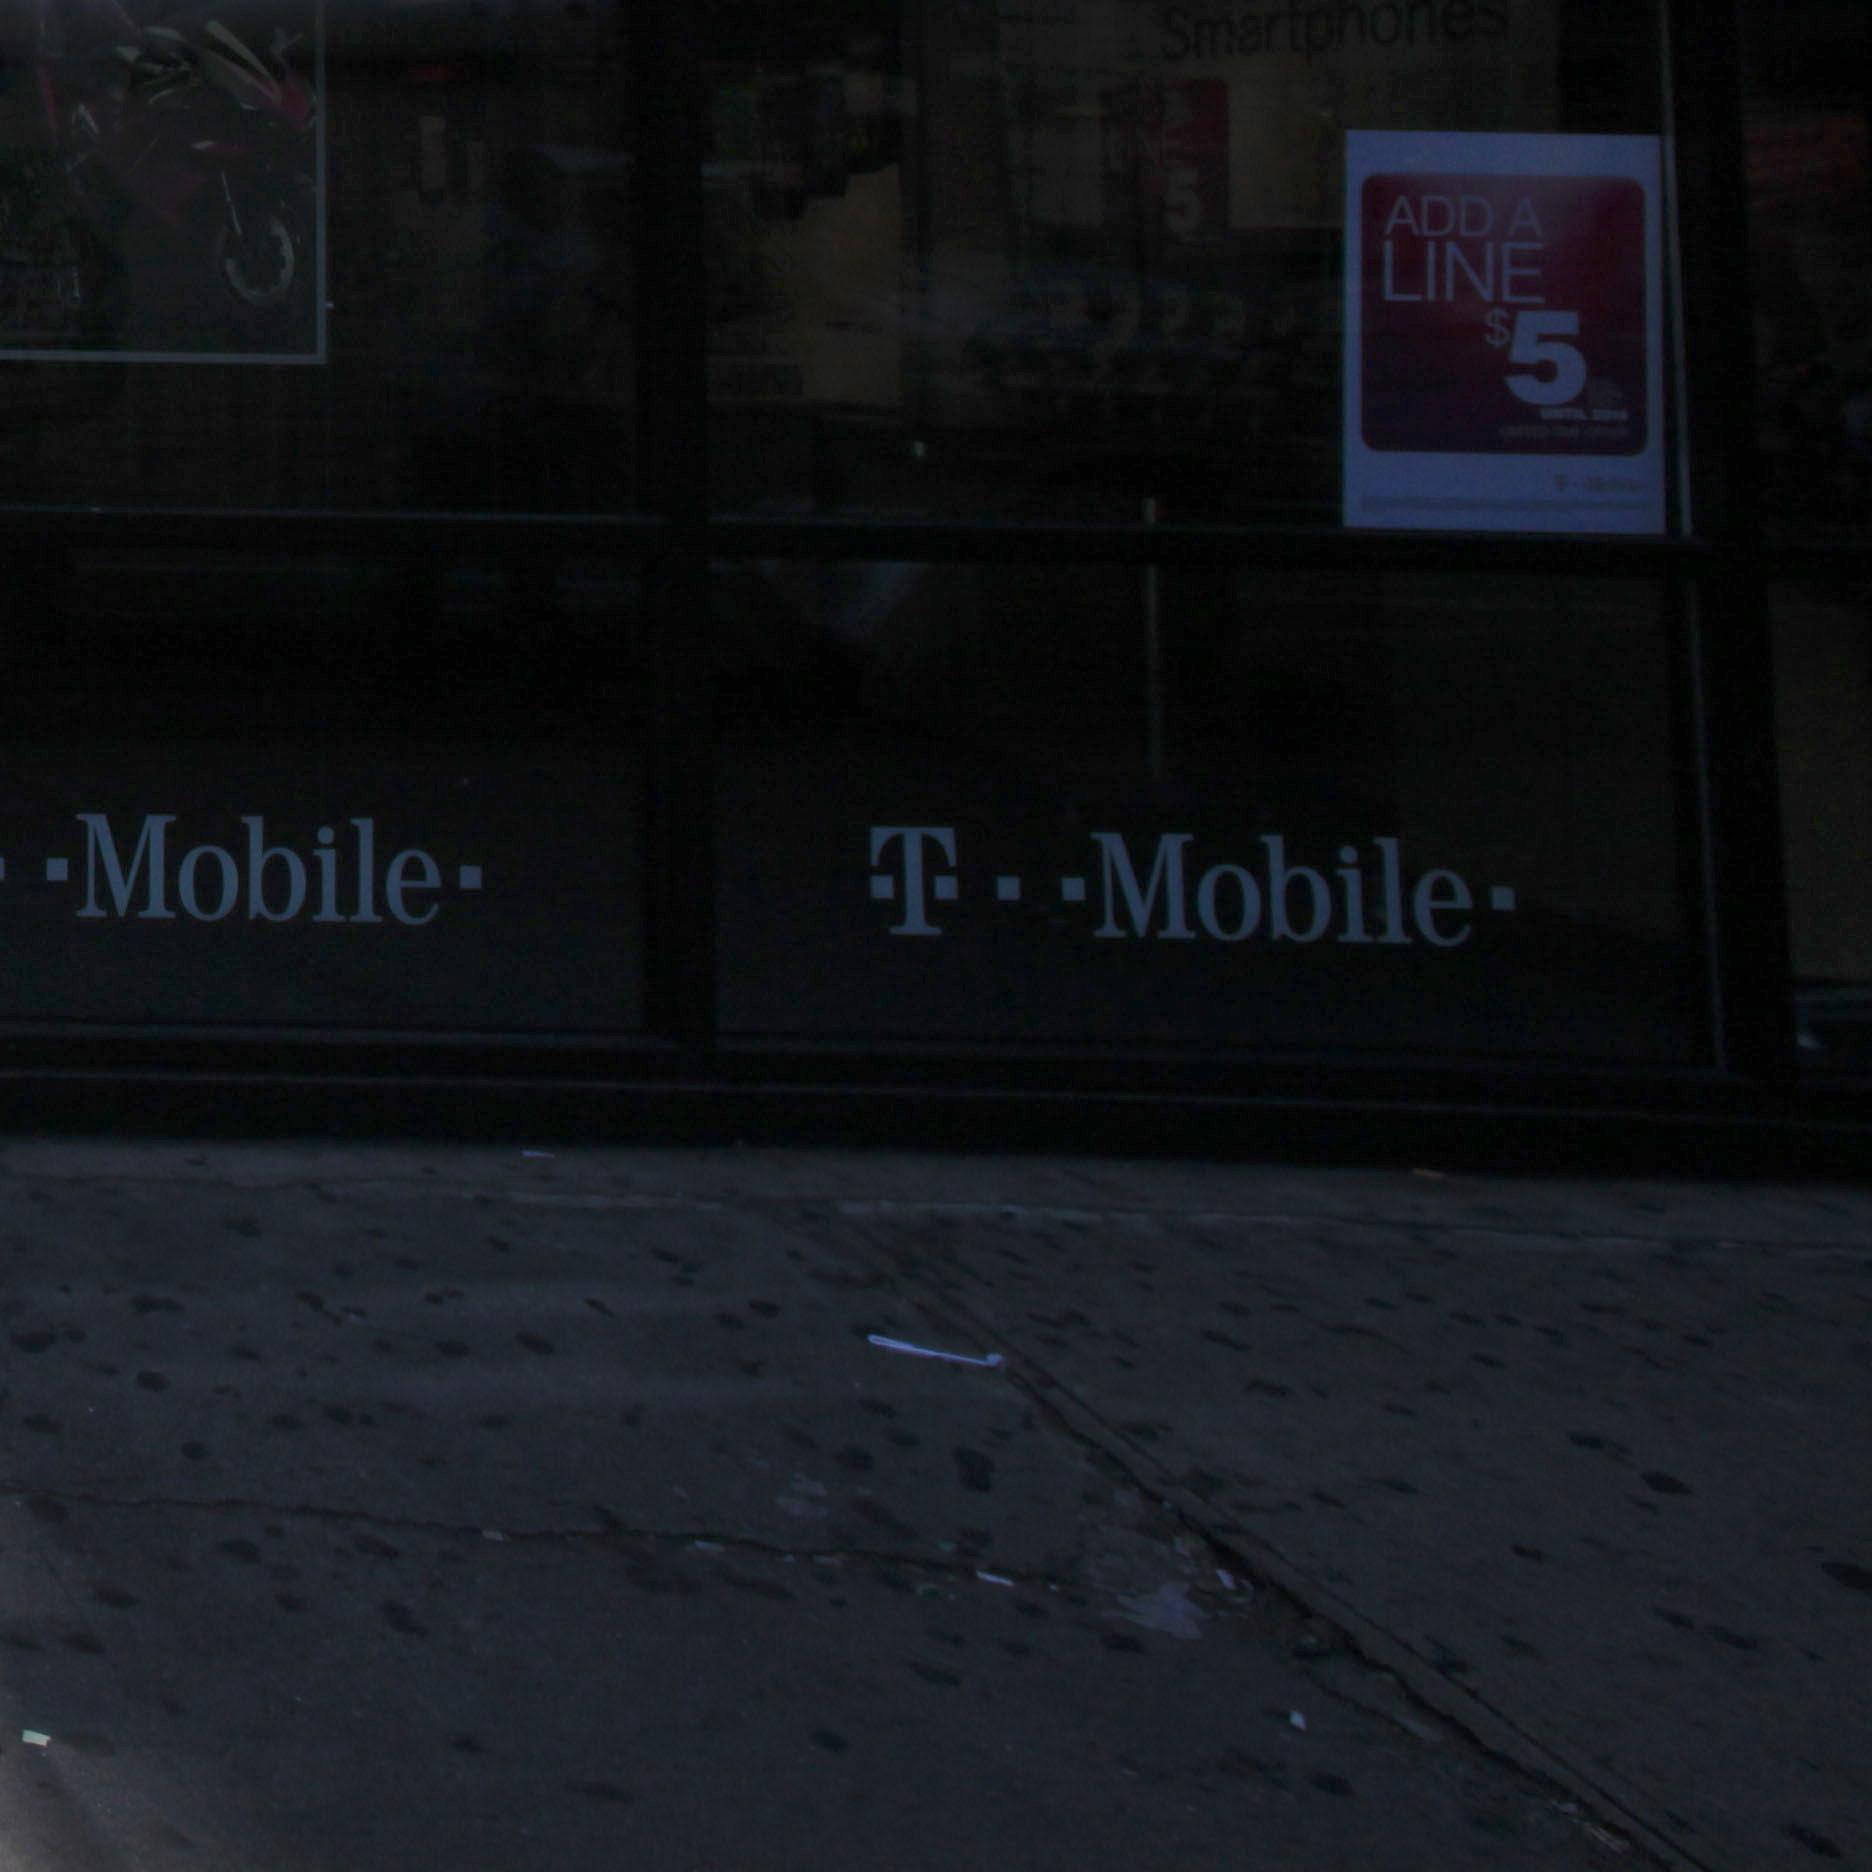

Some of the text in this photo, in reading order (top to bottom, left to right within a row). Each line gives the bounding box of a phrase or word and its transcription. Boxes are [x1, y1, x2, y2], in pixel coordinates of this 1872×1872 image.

[1385, 194, 1544, 237] ADD A
[1381, 241, 1545, 303] LINE
